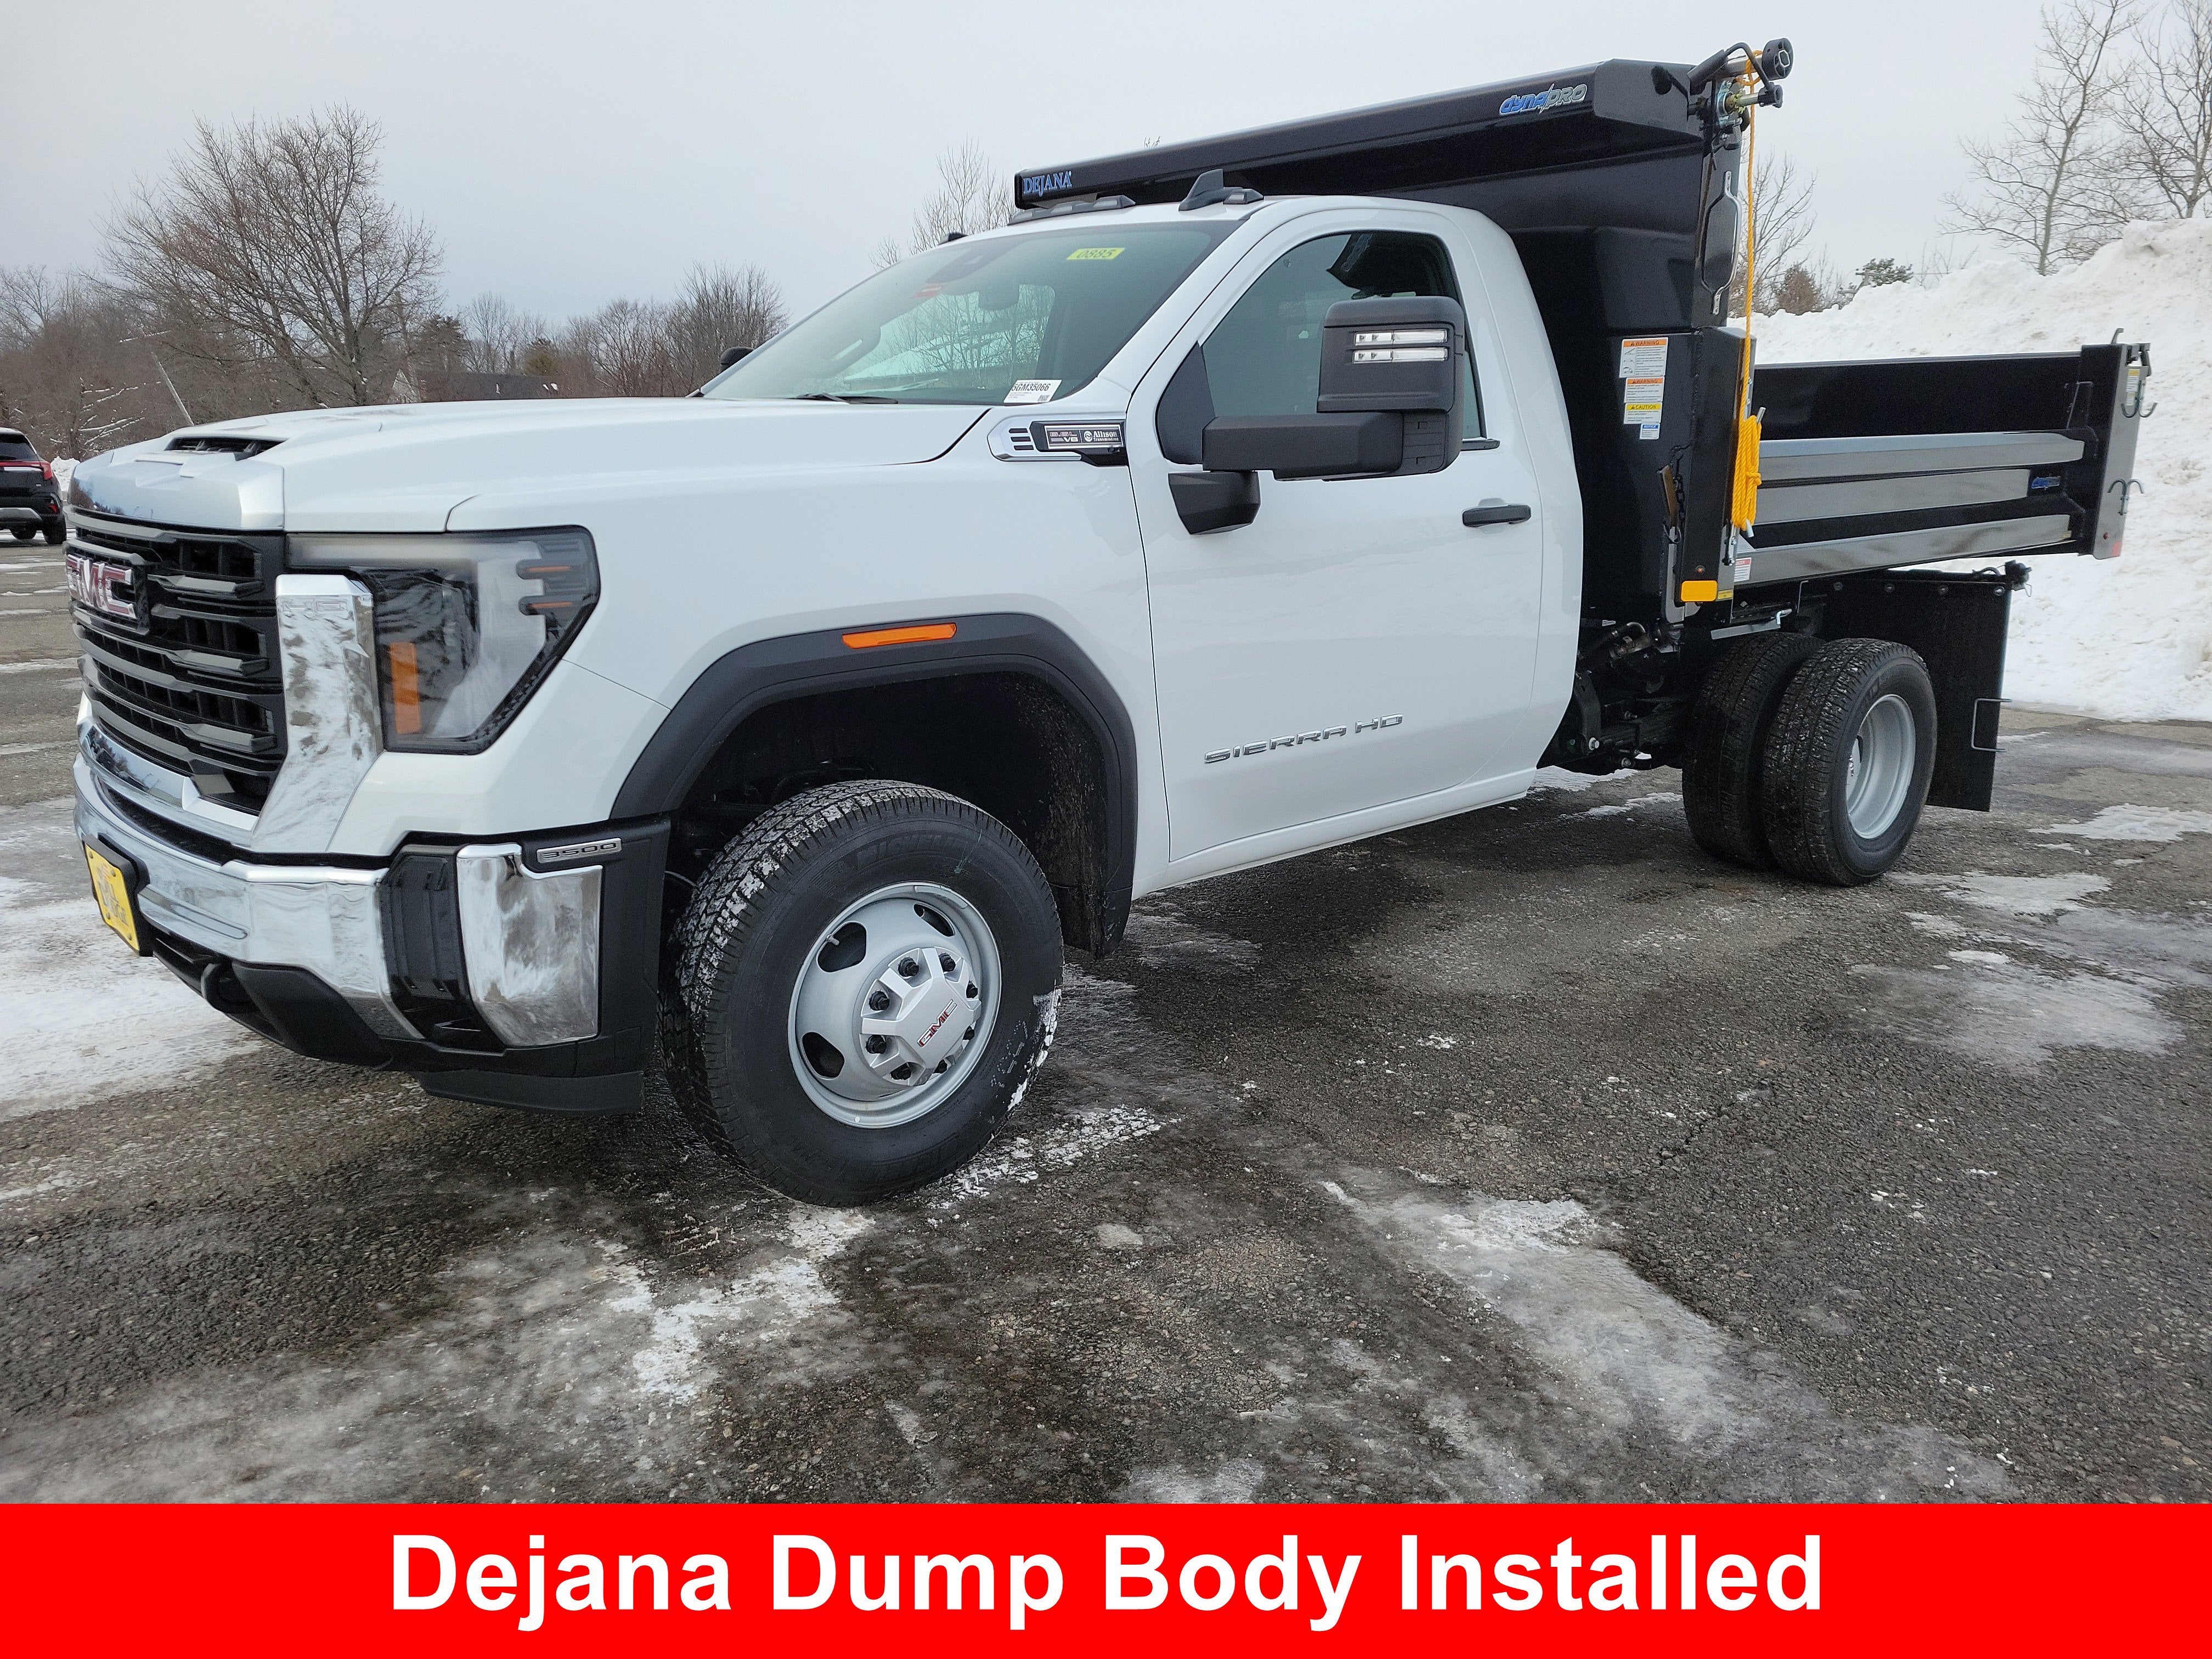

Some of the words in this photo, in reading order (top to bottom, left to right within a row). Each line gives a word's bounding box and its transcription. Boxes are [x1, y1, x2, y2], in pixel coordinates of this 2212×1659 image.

[1023, 171, 1072, 196] DEJANA
[1204, 724, 1347, 764] SIERRA
[1355, 713, 1403, 733] HD
[543, 843, 617, 859] 3500
[917, 999, 957, 1047] GMC
